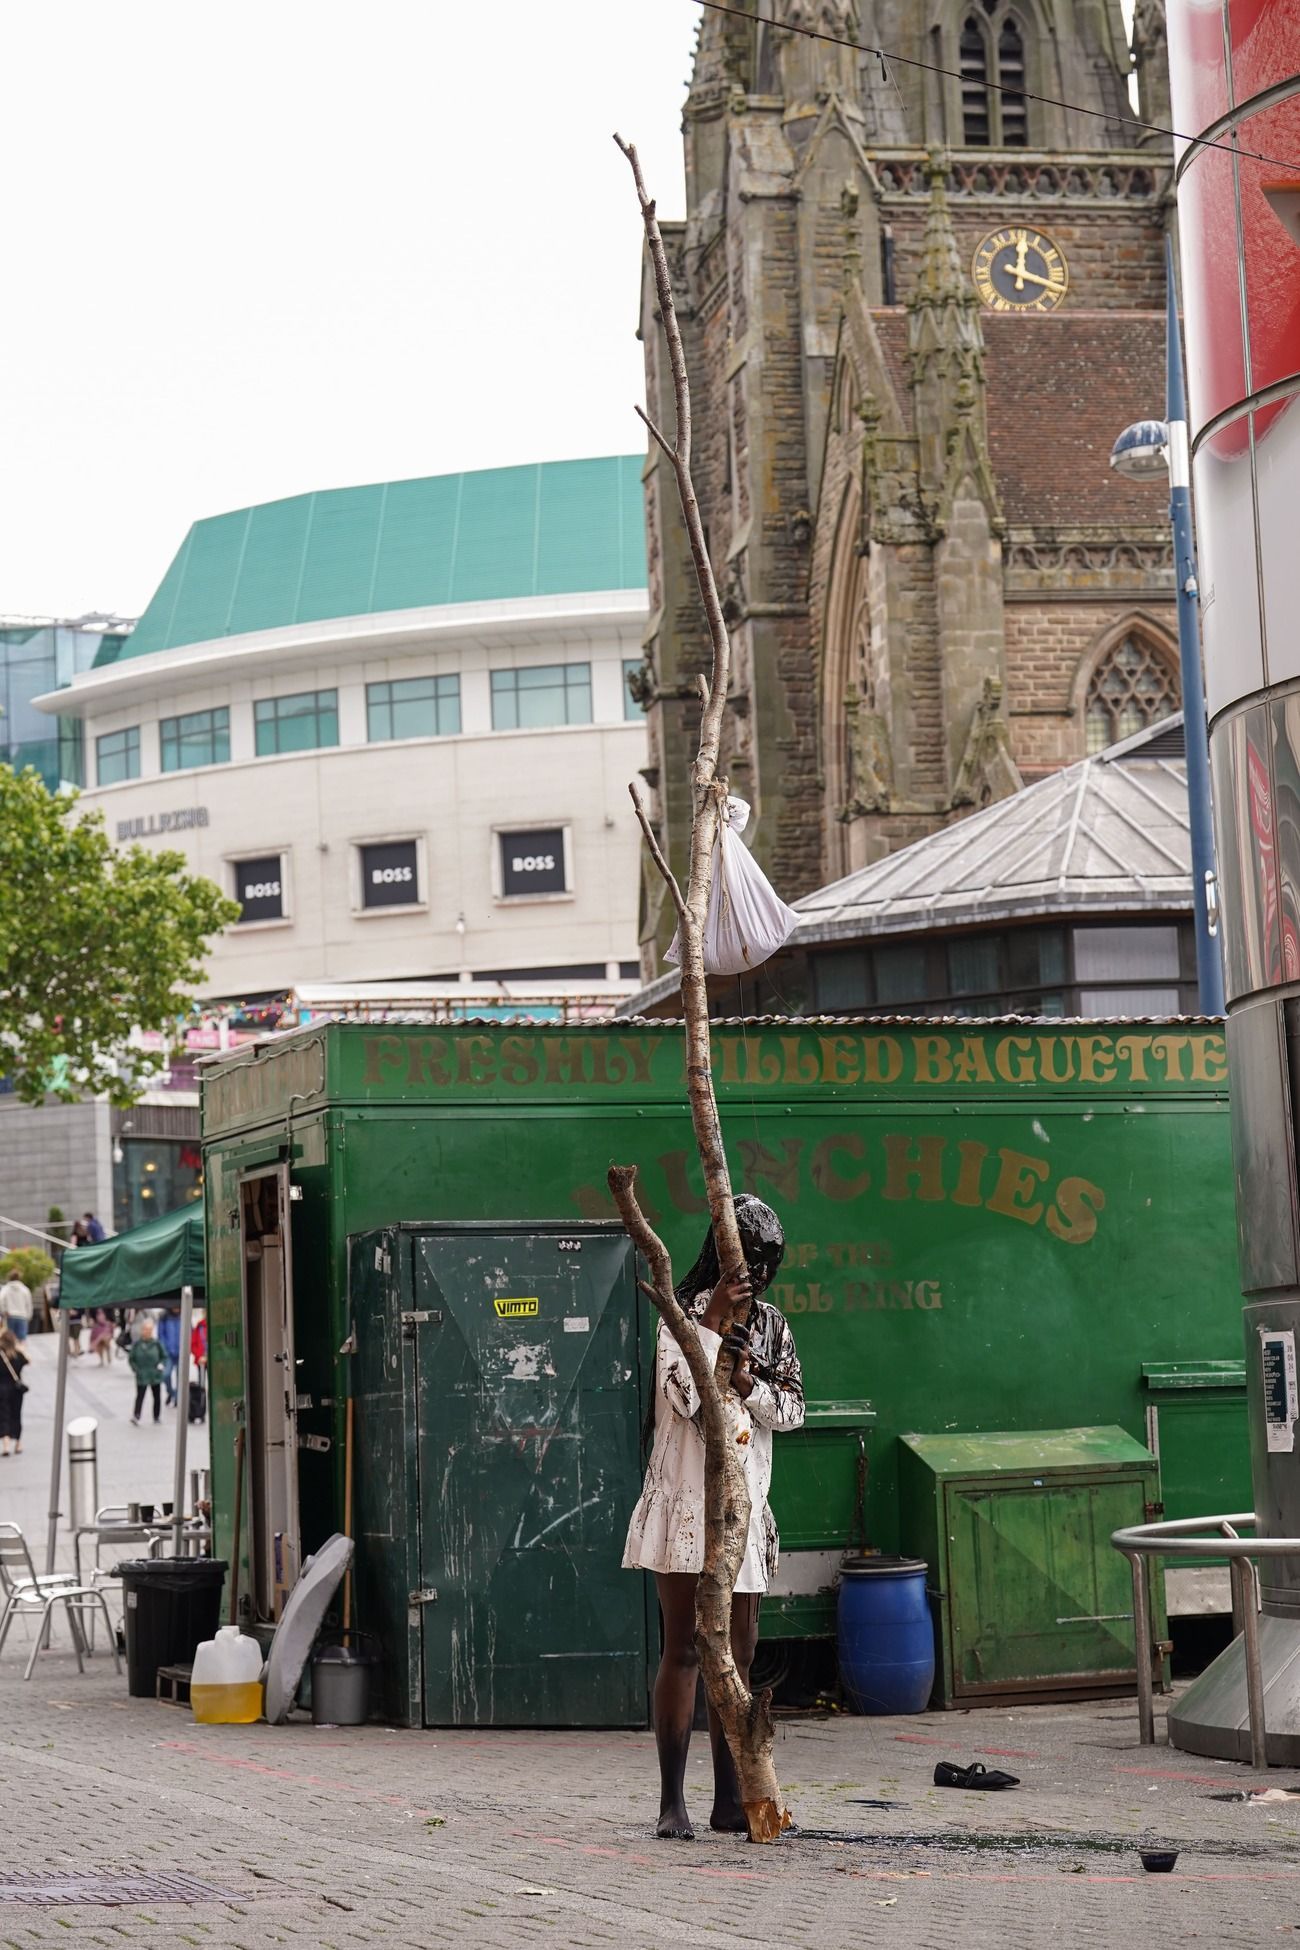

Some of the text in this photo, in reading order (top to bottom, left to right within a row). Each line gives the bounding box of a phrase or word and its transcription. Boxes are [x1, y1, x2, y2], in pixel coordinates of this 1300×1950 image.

[116, 806, 210, 841] BULLRING
[512, 855, 555, 872] BOSS
[372, 867, 412, 884] BOSS
[245, 881, 281, 899] BOSS
[363, 1035, 663, 1085] FRESHLY
[912, 1034, 1229, 1083] BAGUETTE
[844, 1280, 943, 1312] RING
[497, 1301, 537, 1315] VIMTO
